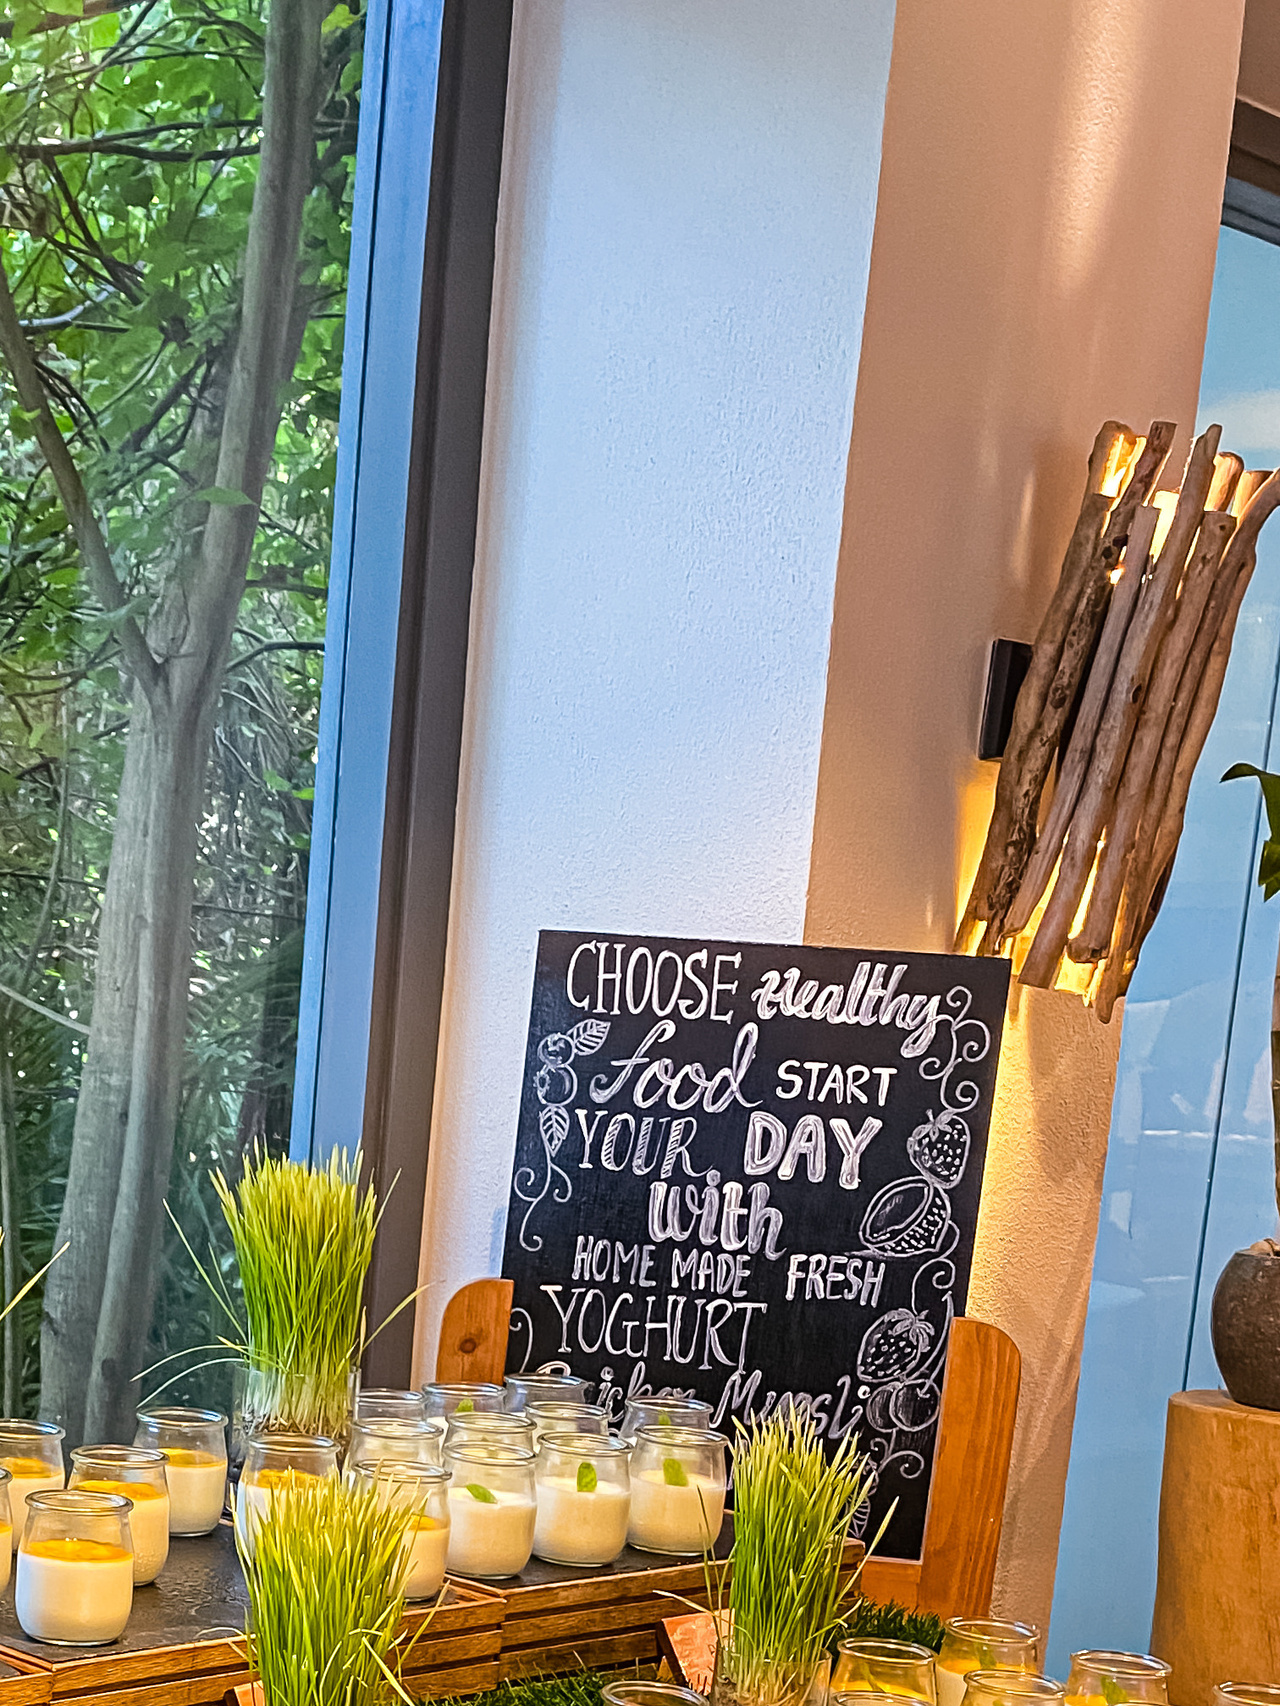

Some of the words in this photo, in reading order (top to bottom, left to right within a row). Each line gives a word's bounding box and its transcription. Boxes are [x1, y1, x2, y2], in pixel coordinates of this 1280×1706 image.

[566, 939, 742, 1024] CHOOSE
[590, 1019, 763, 1113] food
[776, 1060, 898, 1106] START
[574, 1109, 714, 1179] YOUR
[743, 1111, 883, 1190] DAY
[648, 1169, 787, 1260] with
[571, 1235, 656, 1287] HOME
[671, 1248, 751, 1297] MADE
[785, 1254, 886, 1308] FRESH
[540, 1284, 768, 1374] YOGHURT
